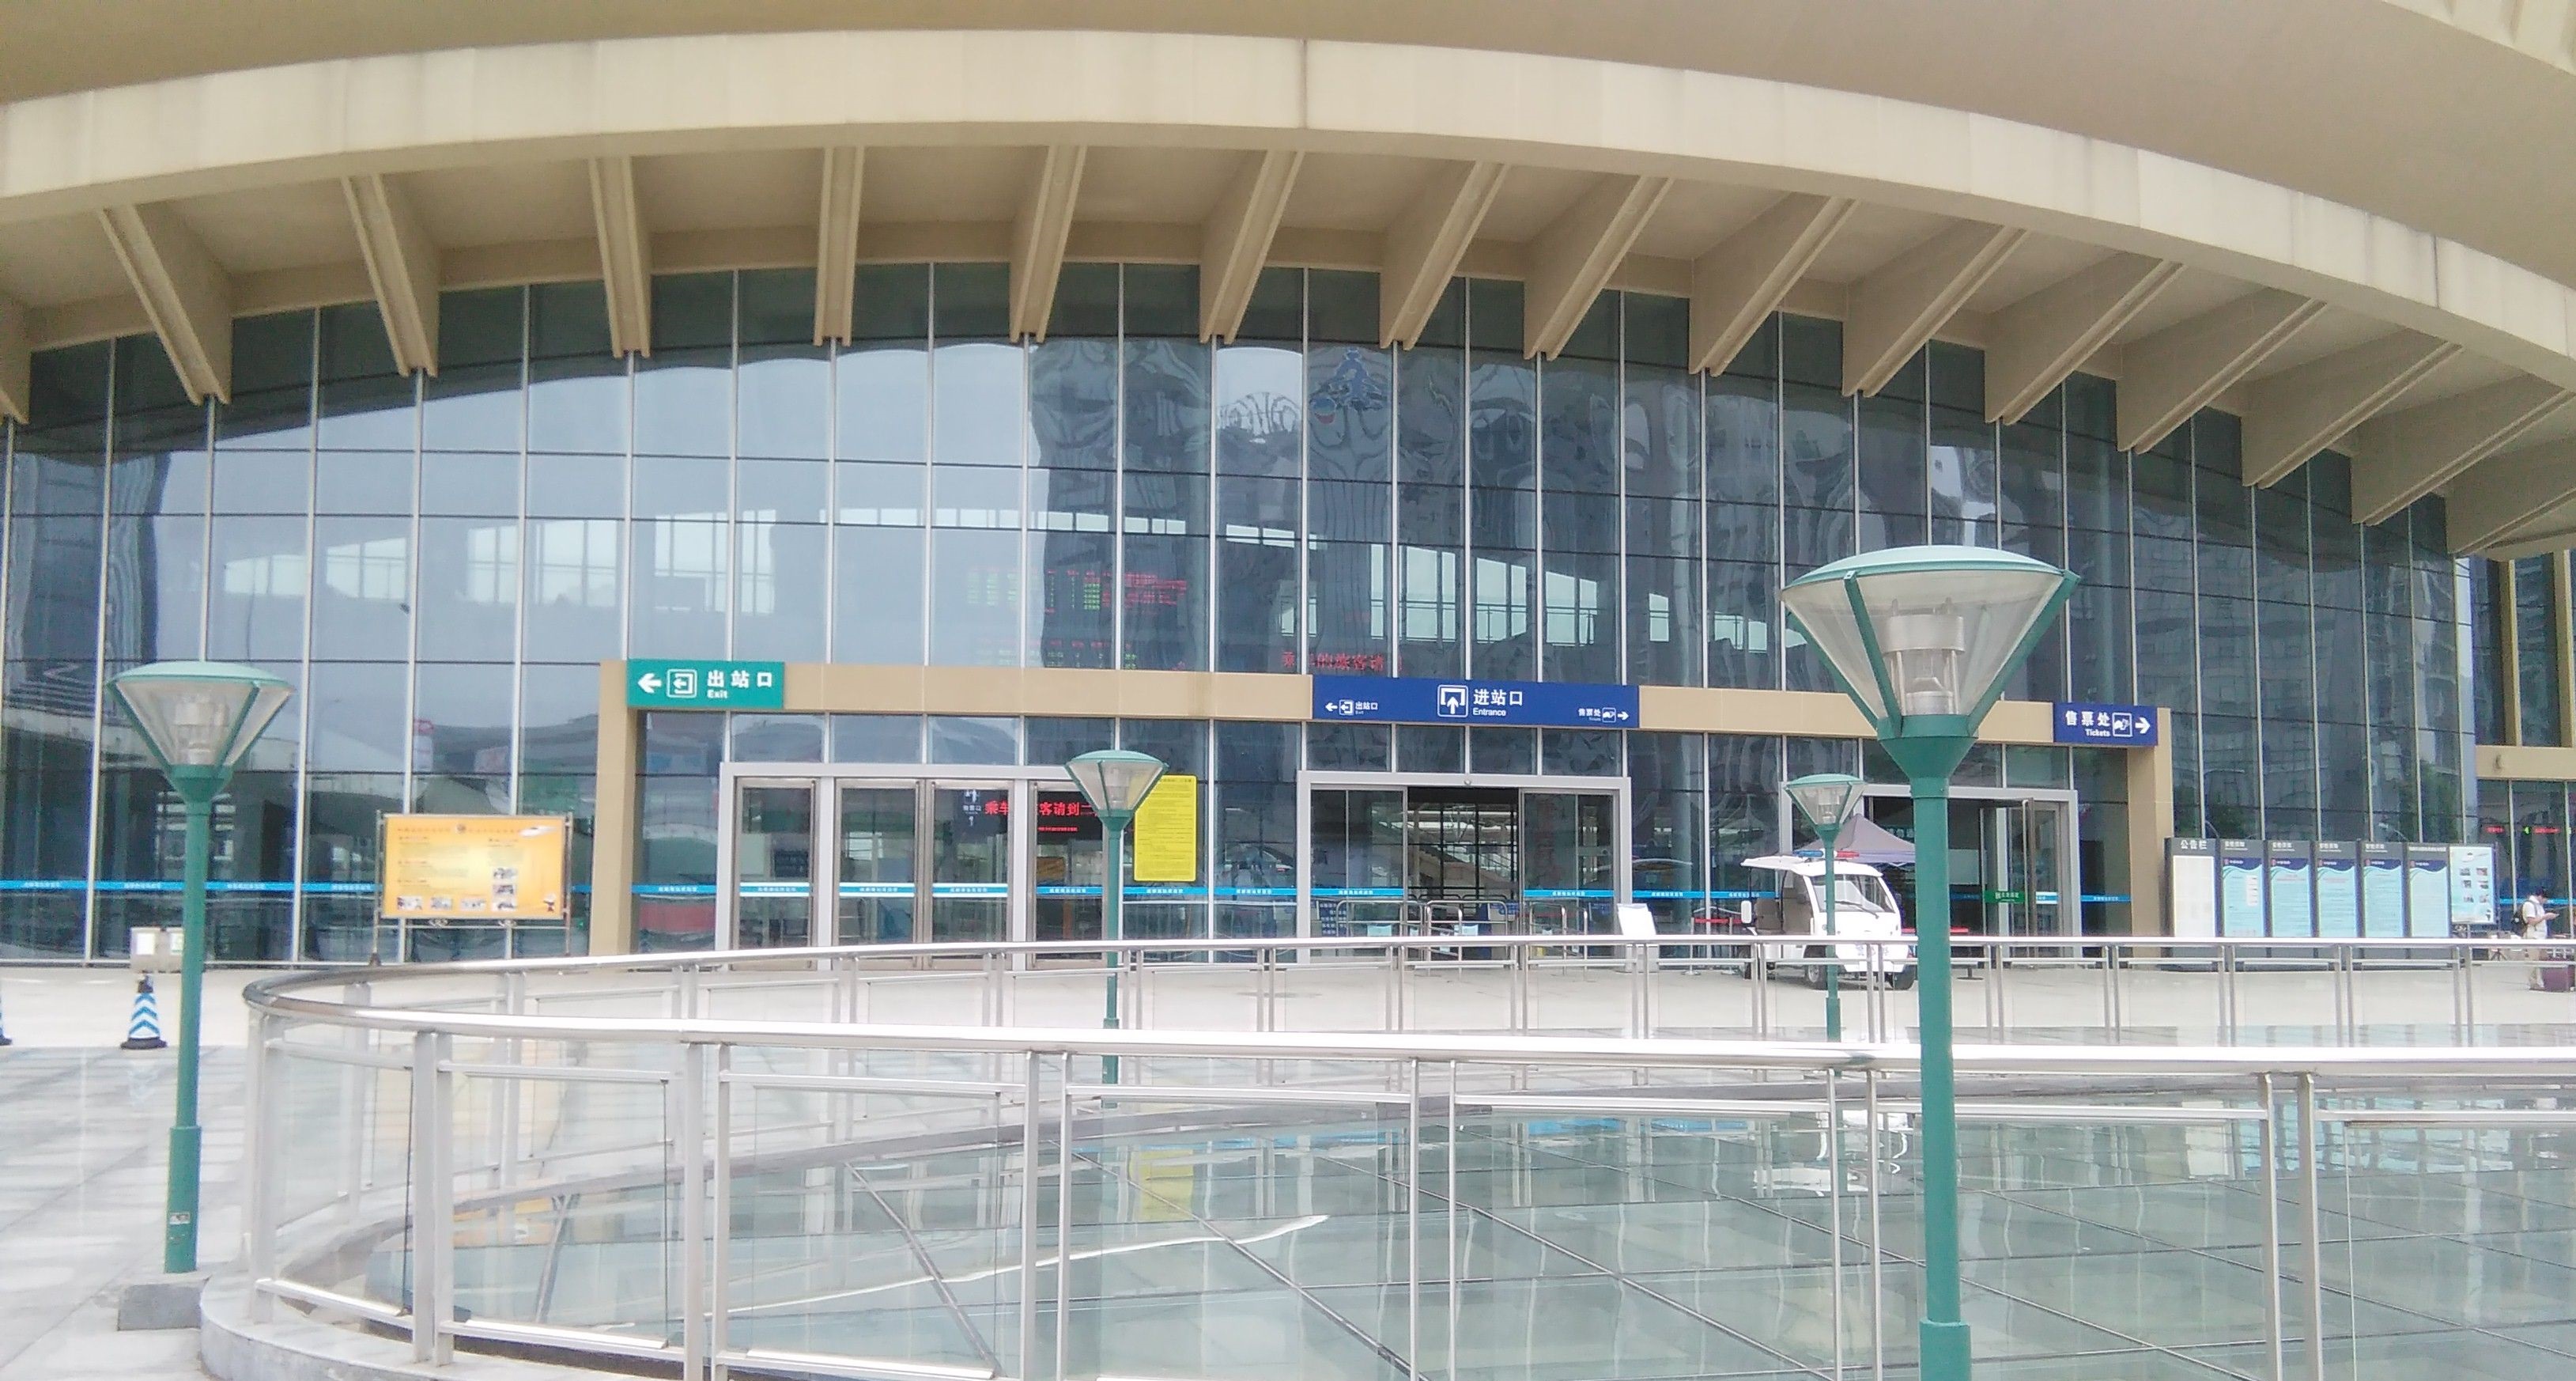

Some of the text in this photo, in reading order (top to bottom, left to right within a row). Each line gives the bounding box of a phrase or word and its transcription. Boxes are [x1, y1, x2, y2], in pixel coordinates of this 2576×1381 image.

[707, 670, 772, 688] 出站口
[707, 690, 727, 698] Exit
[1473, 688, 1523, 706] 进站口
[1354, 702, 1378, 710] 出站口
[1472, 707, 1506, 717] Entrance
[1578, 708, 1601, 717] 售票处
[2065, 710, 2110, 727] 售票处
[2180, 839, 2208, 849] 公告栏
